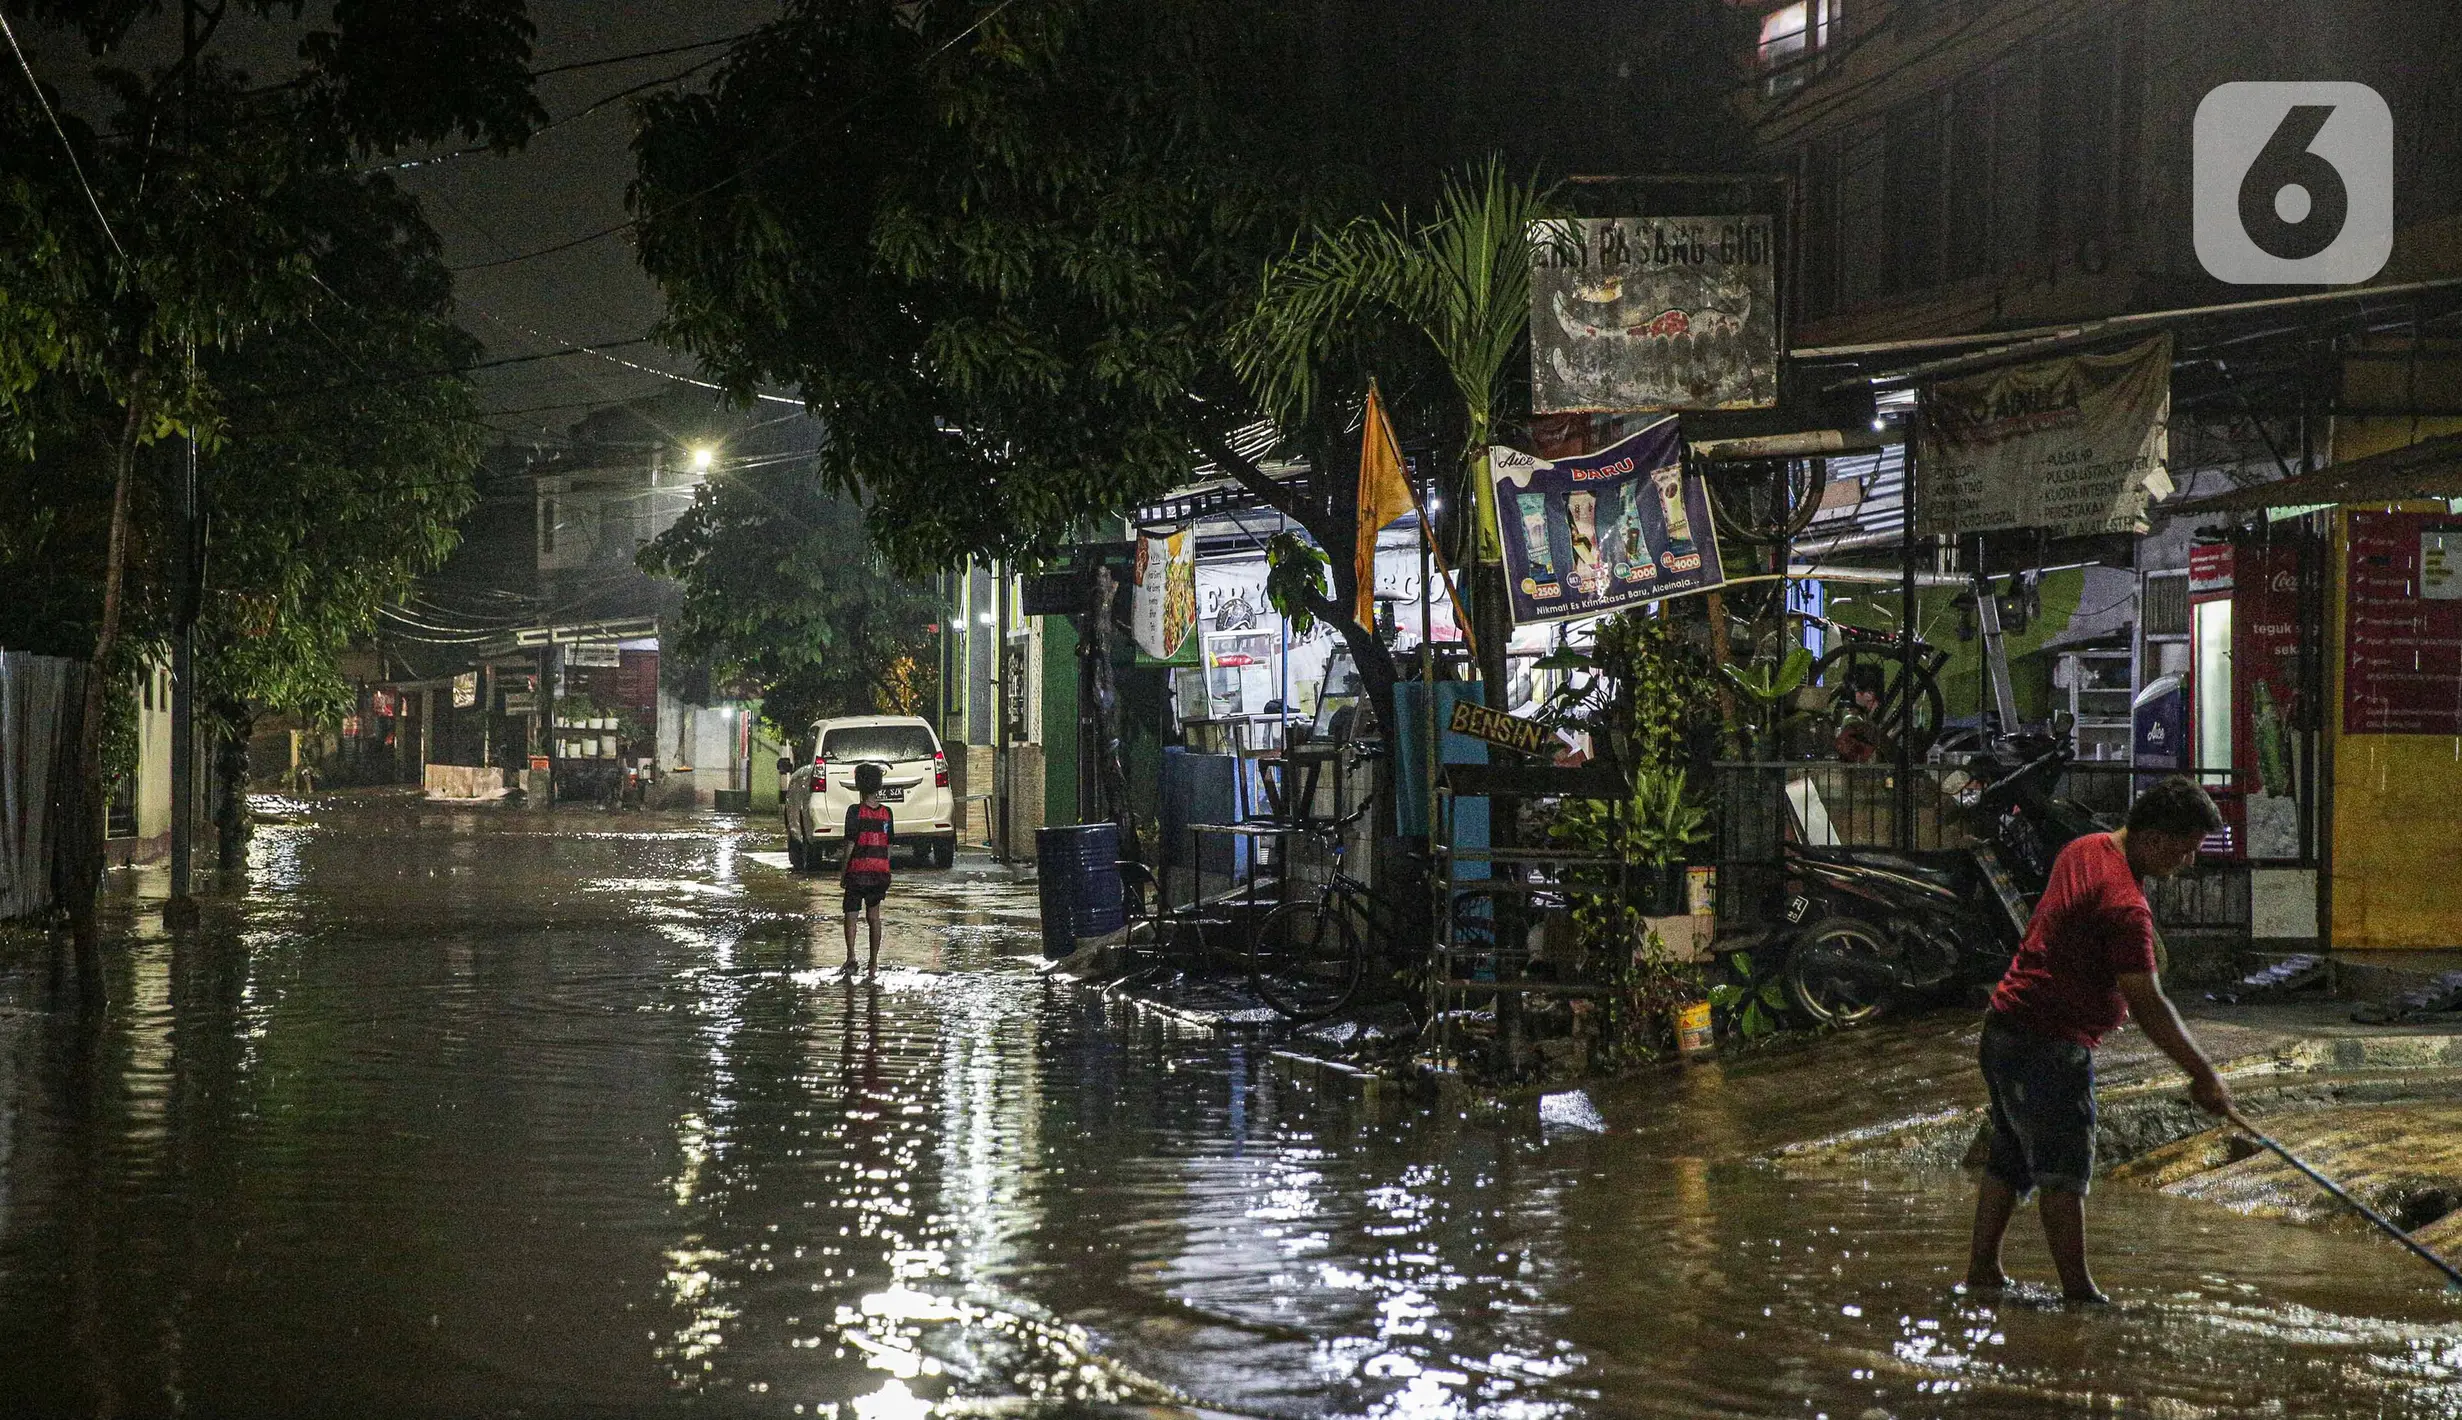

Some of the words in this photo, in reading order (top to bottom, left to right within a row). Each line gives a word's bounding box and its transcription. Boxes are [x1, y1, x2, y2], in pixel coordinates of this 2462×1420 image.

[1498, 451, 1535, 469] Aice
[1536, 603, 1569, 615] Nikmati
[1570, 602, 1580, 610] Es
[2252, 622, 2292, 636] teguk
[1452, 704, 1542, 751] BENSIN
